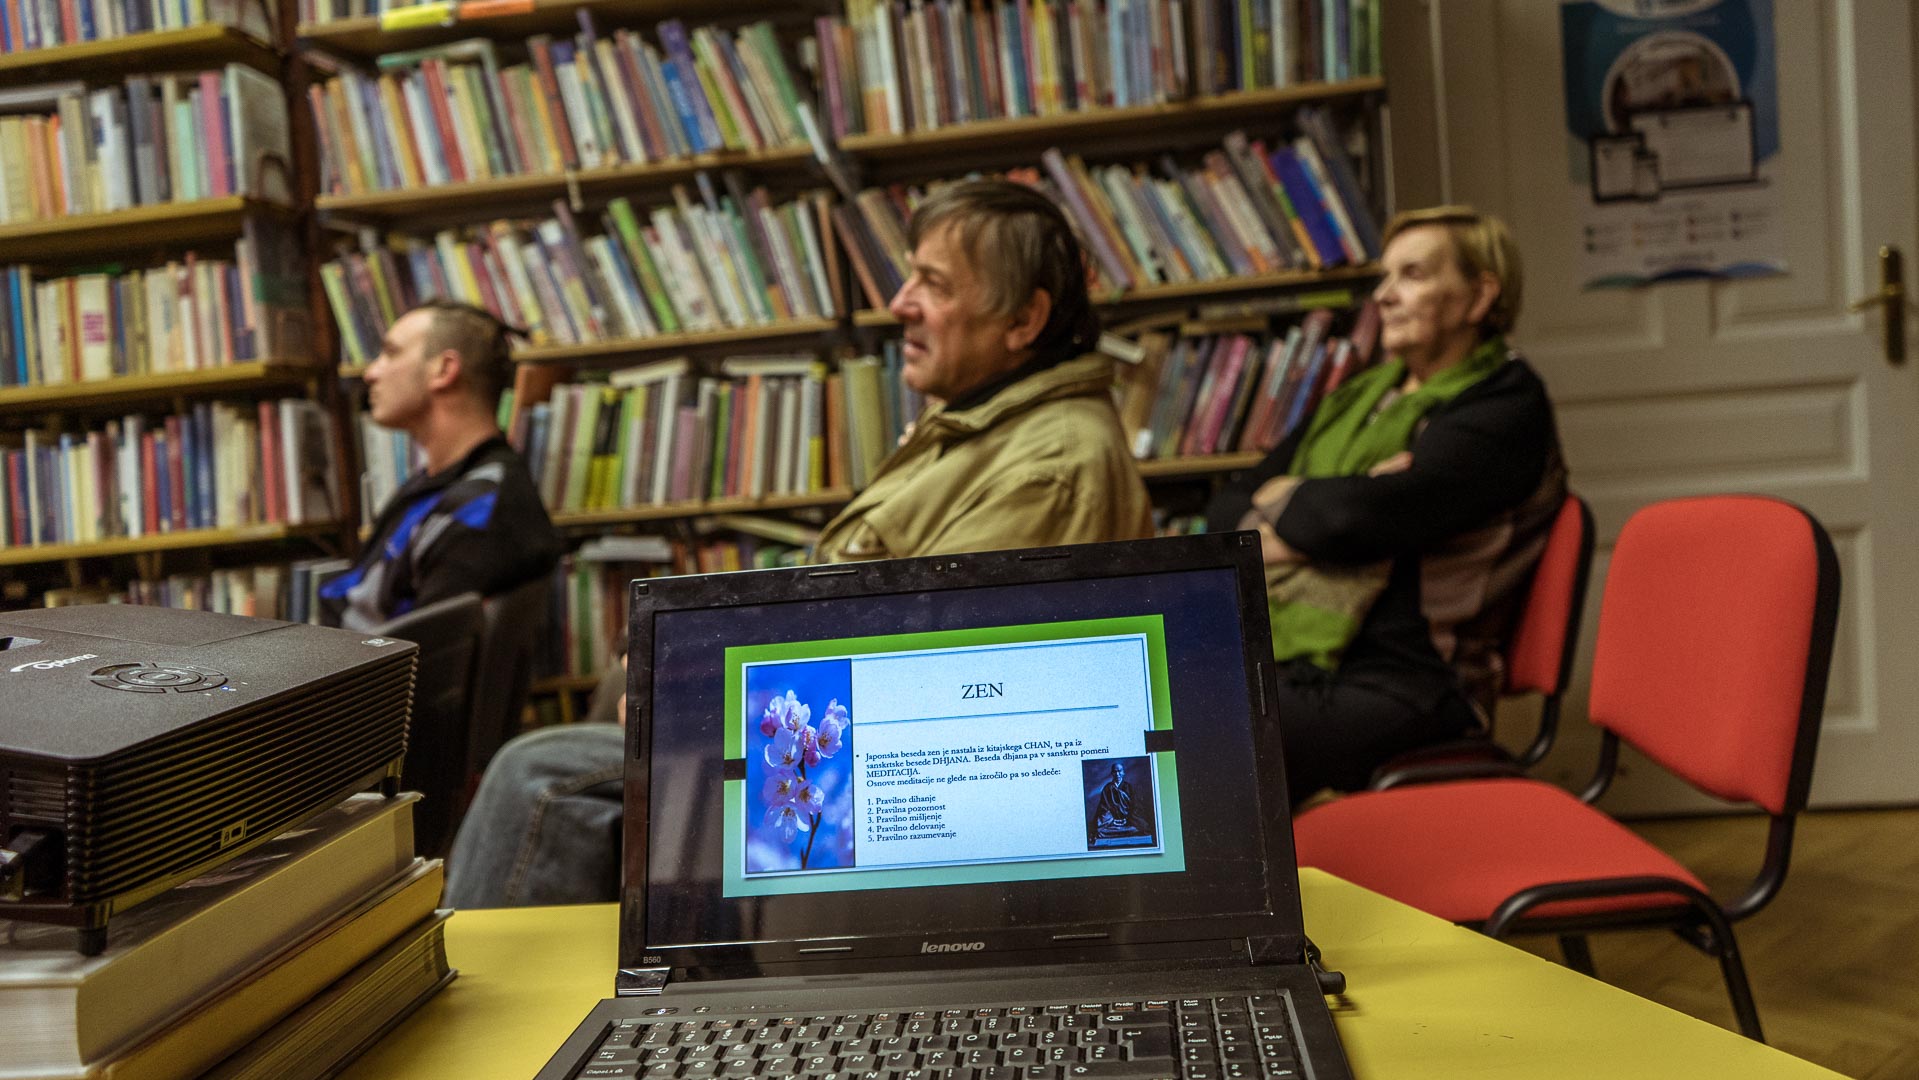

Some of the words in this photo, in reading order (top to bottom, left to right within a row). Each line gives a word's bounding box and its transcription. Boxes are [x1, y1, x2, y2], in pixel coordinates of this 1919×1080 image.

[33, 653, 98, 670] Optoma
[961, 682, 1003, 699] ZEN
[865, 752, 899, 762] Japonska
[901, 750, 926, 758] beseda
[942, 748, 950, 757] je
[951, 746, 976, 755] nastala
[977, 745, 985, 753] iz
[986, 743, 1022, 753] kitajskega
[1024, 740, 1053, 750] CHAN,
[1064, 740, 1074, 748] pa
[1075, 738, 1083, 746] iz
[866, 760, 904, 769] sanskrtske
[906, 758, 931, 767] besede
[932, 756, 971, 766] DHJANA.
[974, 754, 1001, 762] Beseda
[1002, 752, 1028, 762] dhjana
[1029, 752, 1039, 761] pa
[1047, 749, 1079, 757] sanskrtu
[1080, 746, 1109, 757] pomeni
[866, 768, 921, 778] MEDITACIJA.
[897, 776, 935, 785] meditacije
[947, 774, 967, 784] glede
[979, 771, 1008, 780] izročilo
[1009, 772, 1020, 780] pa
[1031, 768, 1061, 777] sledeče:
[867, 798, 875, 806] 1.
[875, 797, 907, 805] Pravilno
[908, 795, 936, 803] dihanje
[867, 807, 875, 815] 2.
[876, 806, 906, 814] Pravilna
[907, 804, 946, 814] pozornost
[867, 816, 875, 824] 3.
[876, 815, 907, 823] Pravilno
[909, 812, 942, 822] mišljenje
[867, 825, 875, 833] 4.
[876, 824, 908, 833] Pravilno
[909, 822, 946, 831] delovanje
[876, 833, 908, 842] Pravilno
[910, 830, 957, 839] razumevanje
[921, 941, 985, 953] lenovo
[643, 956, 662, 964] B560
[865, 1071, 878, 1079] N
